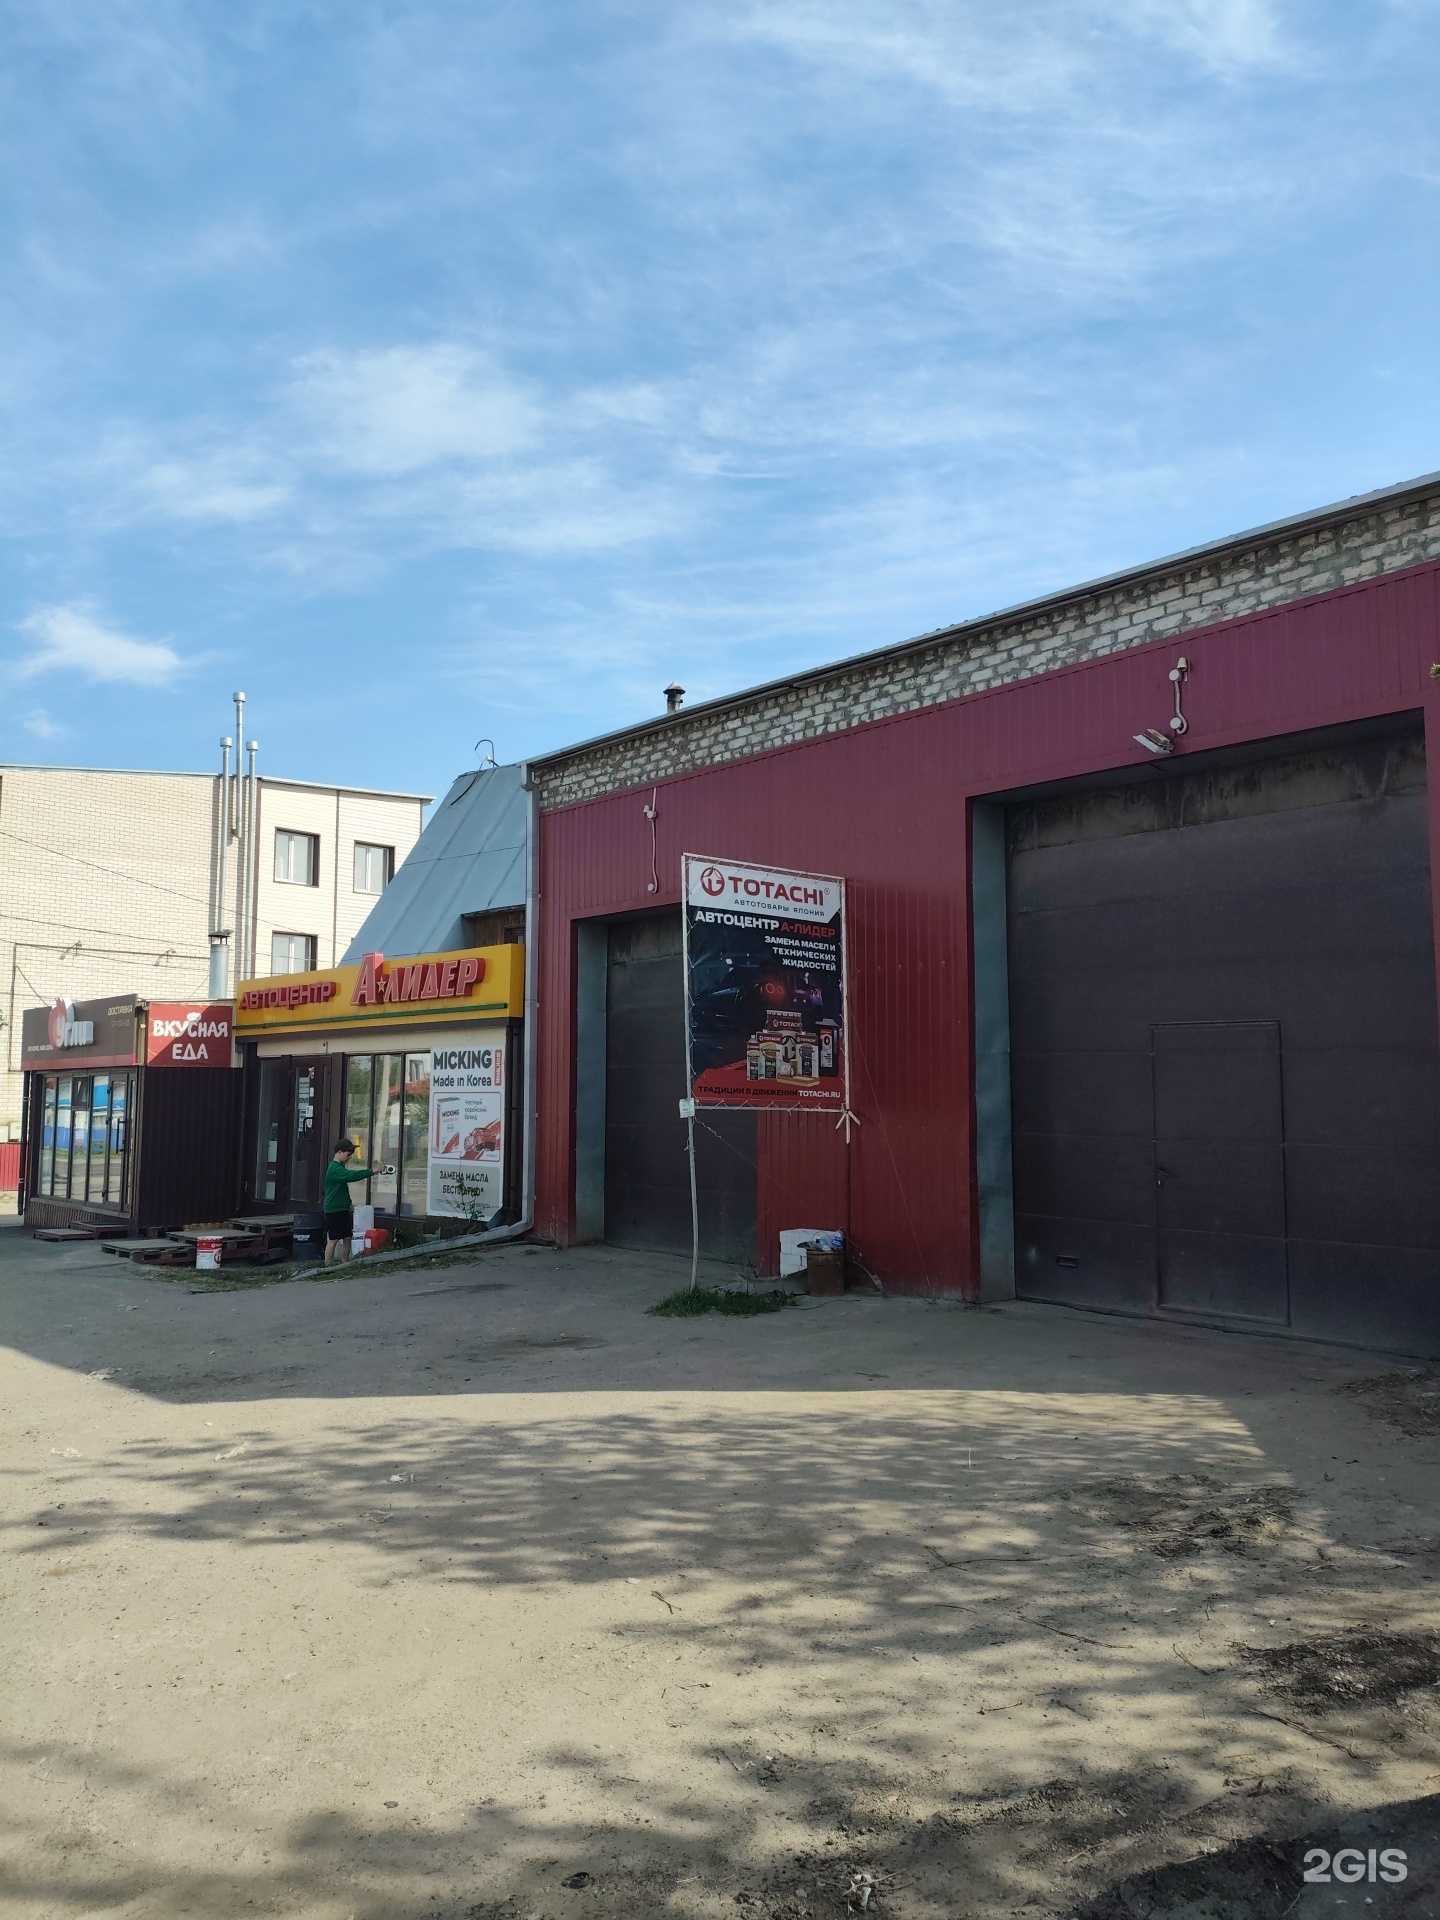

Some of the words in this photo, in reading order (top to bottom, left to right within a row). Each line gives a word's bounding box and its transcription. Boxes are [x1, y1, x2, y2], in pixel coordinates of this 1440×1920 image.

[728, 876, 824, 906] TOTACHI
[734, 899, 790, 912] АВТОТОВАРЫ
[793, 908, 825, 917] ЯПОНИЯ
[695, 910, 780, 931] АВТОЦЕНТР
[764, 935, 801, 947] ЗАМЕНА
[801, 941, 829, 951] МАСЕЛ
[829, 944, 836, 952] И
[772, 946, 836, 962] ТЕХНИЧЕСКИХ
[782, 958, 837, 972] ЖИДКОСТЕЙ
[239, 981, 337, 1010] АВТОЦЕНТР
[153, 1019, 228, 1038] ВКУСНАЯ
[172, 1043, 209, 1060] ЕДА
[433, 1049, 492, 1070] MICKING
[433, 1074, 455, 1087] Made
[457, 1075, 464, 1087] in
[467, 1074, 492, 1087] Korea
[799, 1090, 841, 1098] TOTACHI.RU
[439, 1170, 465, 1181] ЗАМЕНА
[465, 1173, 489, 1183] МАСЛА
